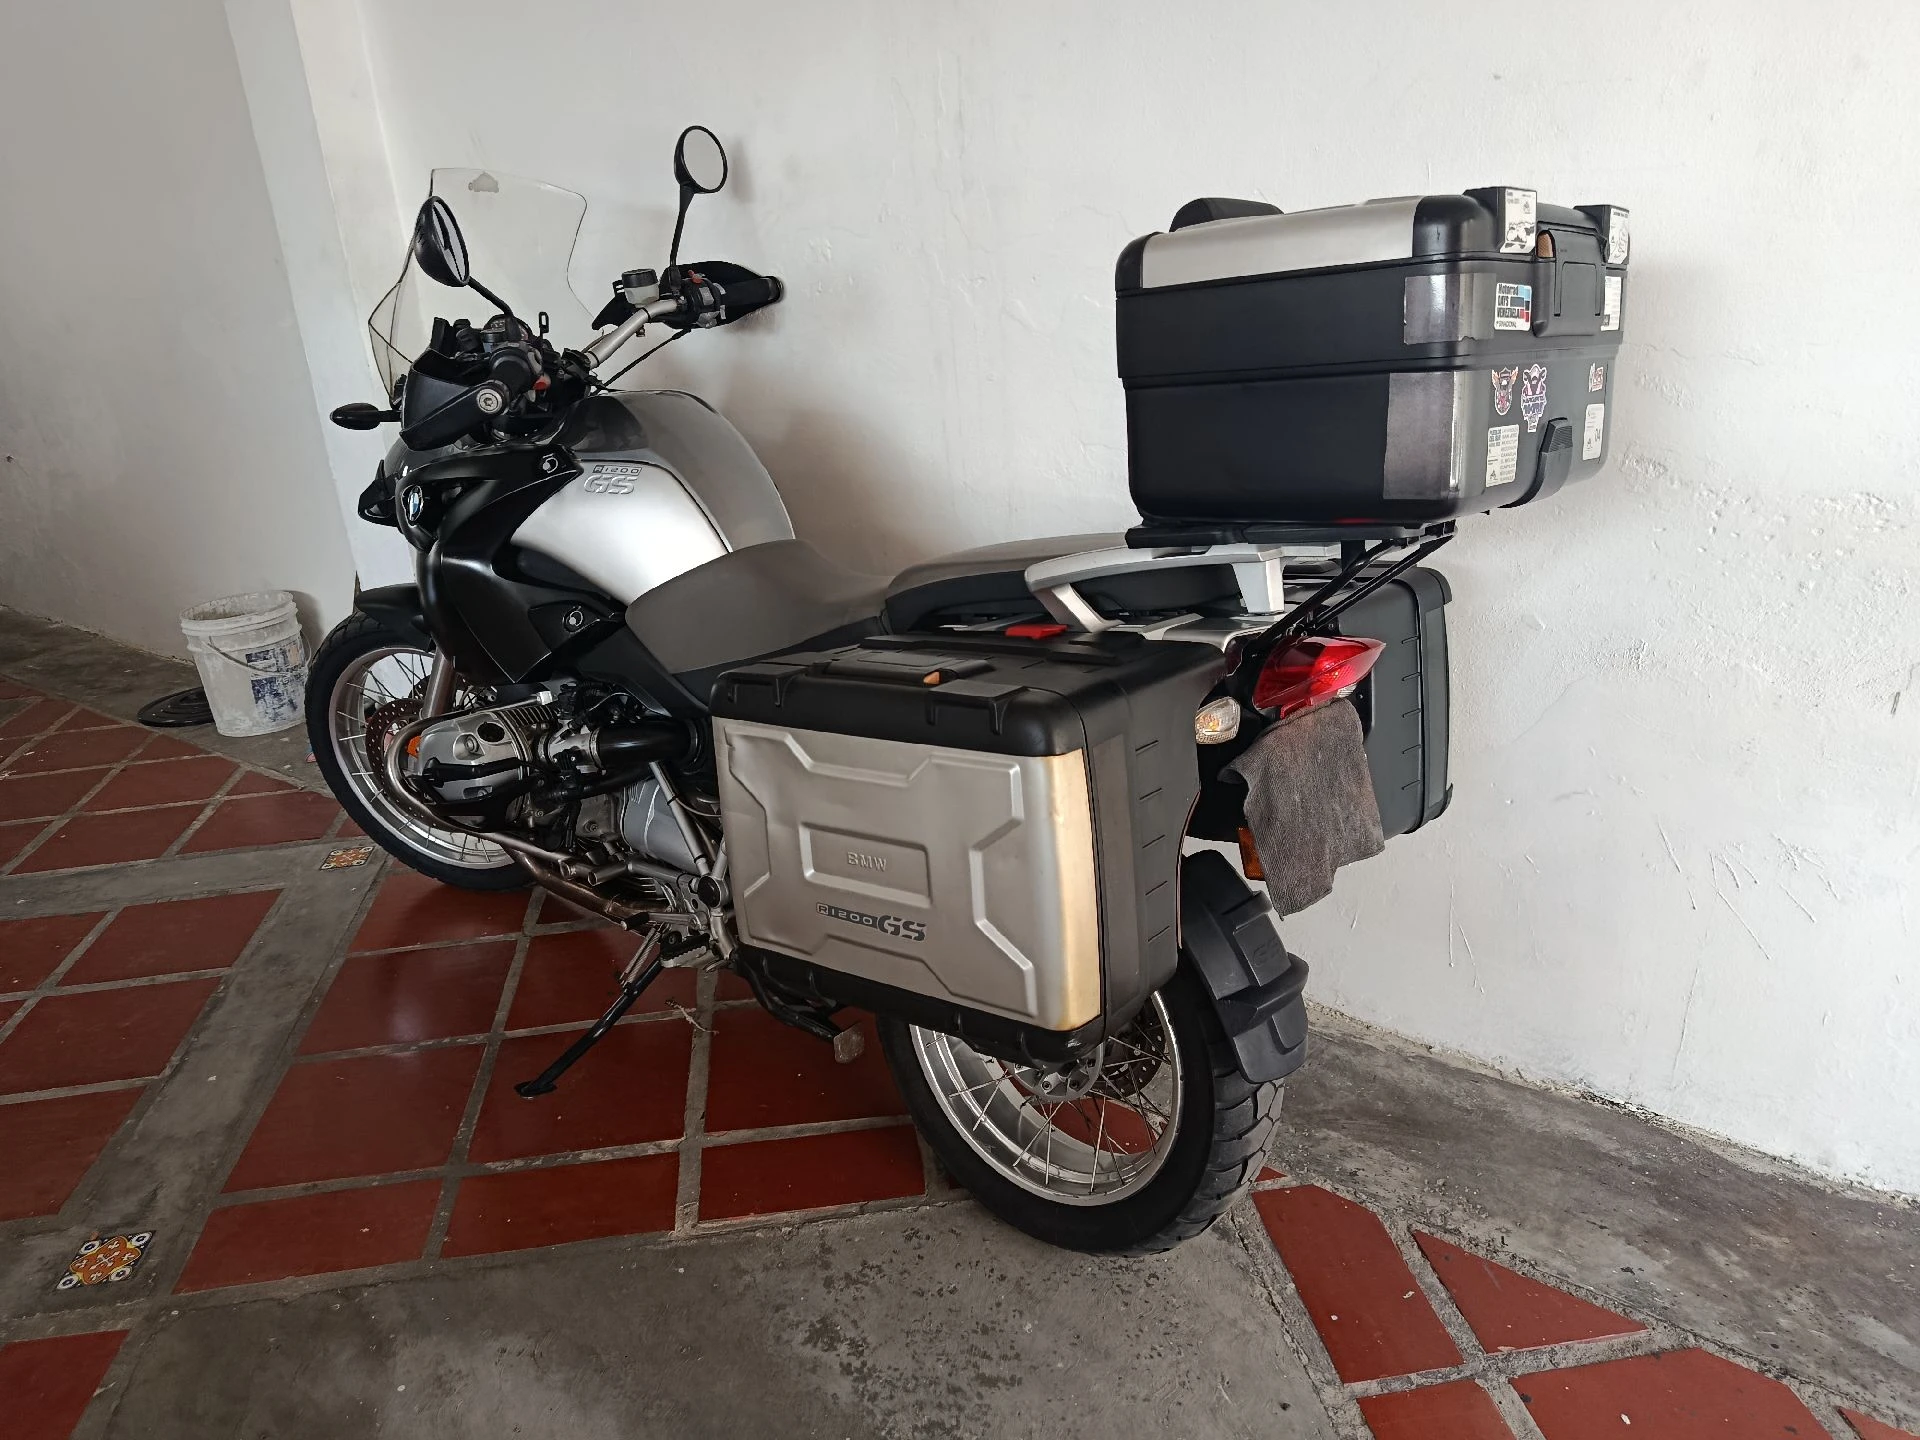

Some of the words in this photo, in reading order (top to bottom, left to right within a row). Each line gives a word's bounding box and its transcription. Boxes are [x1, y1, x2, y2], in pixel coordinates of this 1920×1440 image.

[592, 465, 641, 476] R1200
[584, 474, 637, 494] GS
[847, 851, 887, 872] BMW
